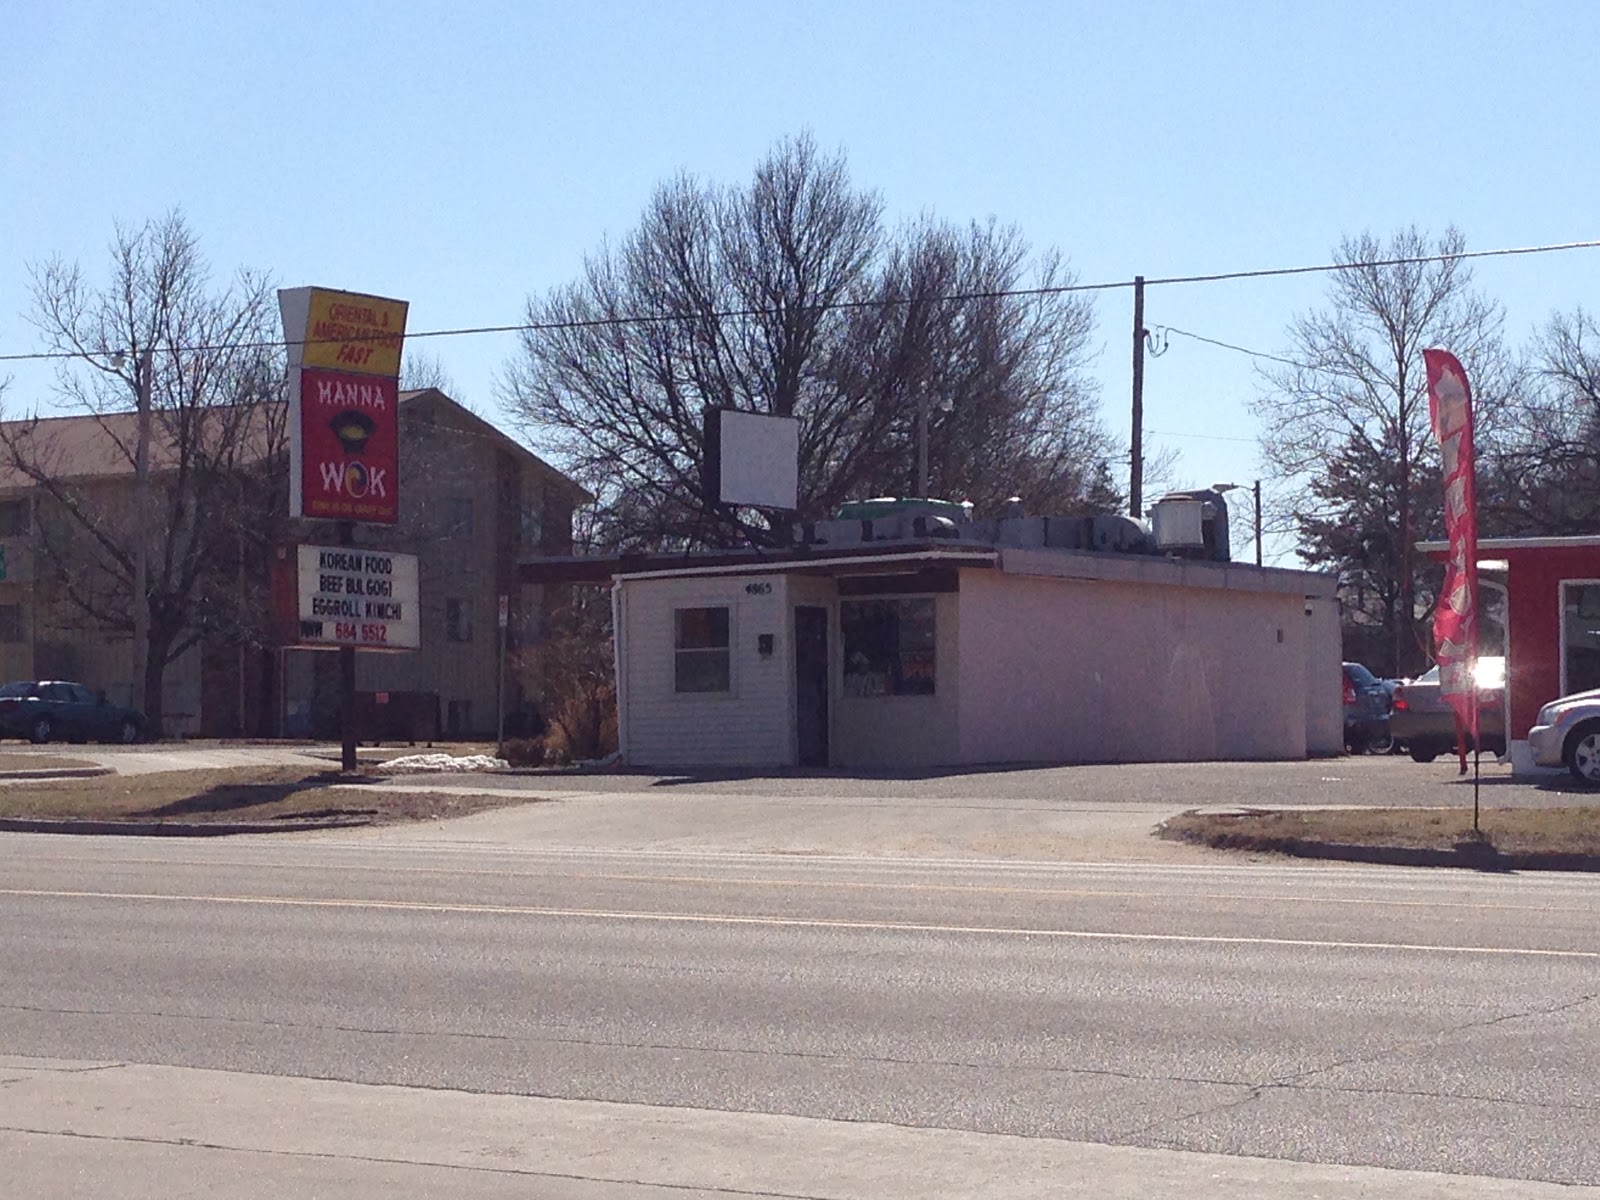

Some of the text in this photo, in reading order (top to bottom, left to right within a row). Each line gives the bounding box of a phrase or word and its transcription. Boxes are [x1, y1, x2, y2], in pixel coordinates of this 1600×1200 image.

[336, 344, 375, 365] FAST
[317, 380, 386, 411] MANNA
[319, 460, 387, 499] WOK
[319, 551, 393, 575] KOREAN FOOD
[319, 573, 343, 593] BEEF
[312, 597, 361, 618] EGGROLL
[335, 622, 357, 640] 684
[361, 623, 388, 642] 5512
